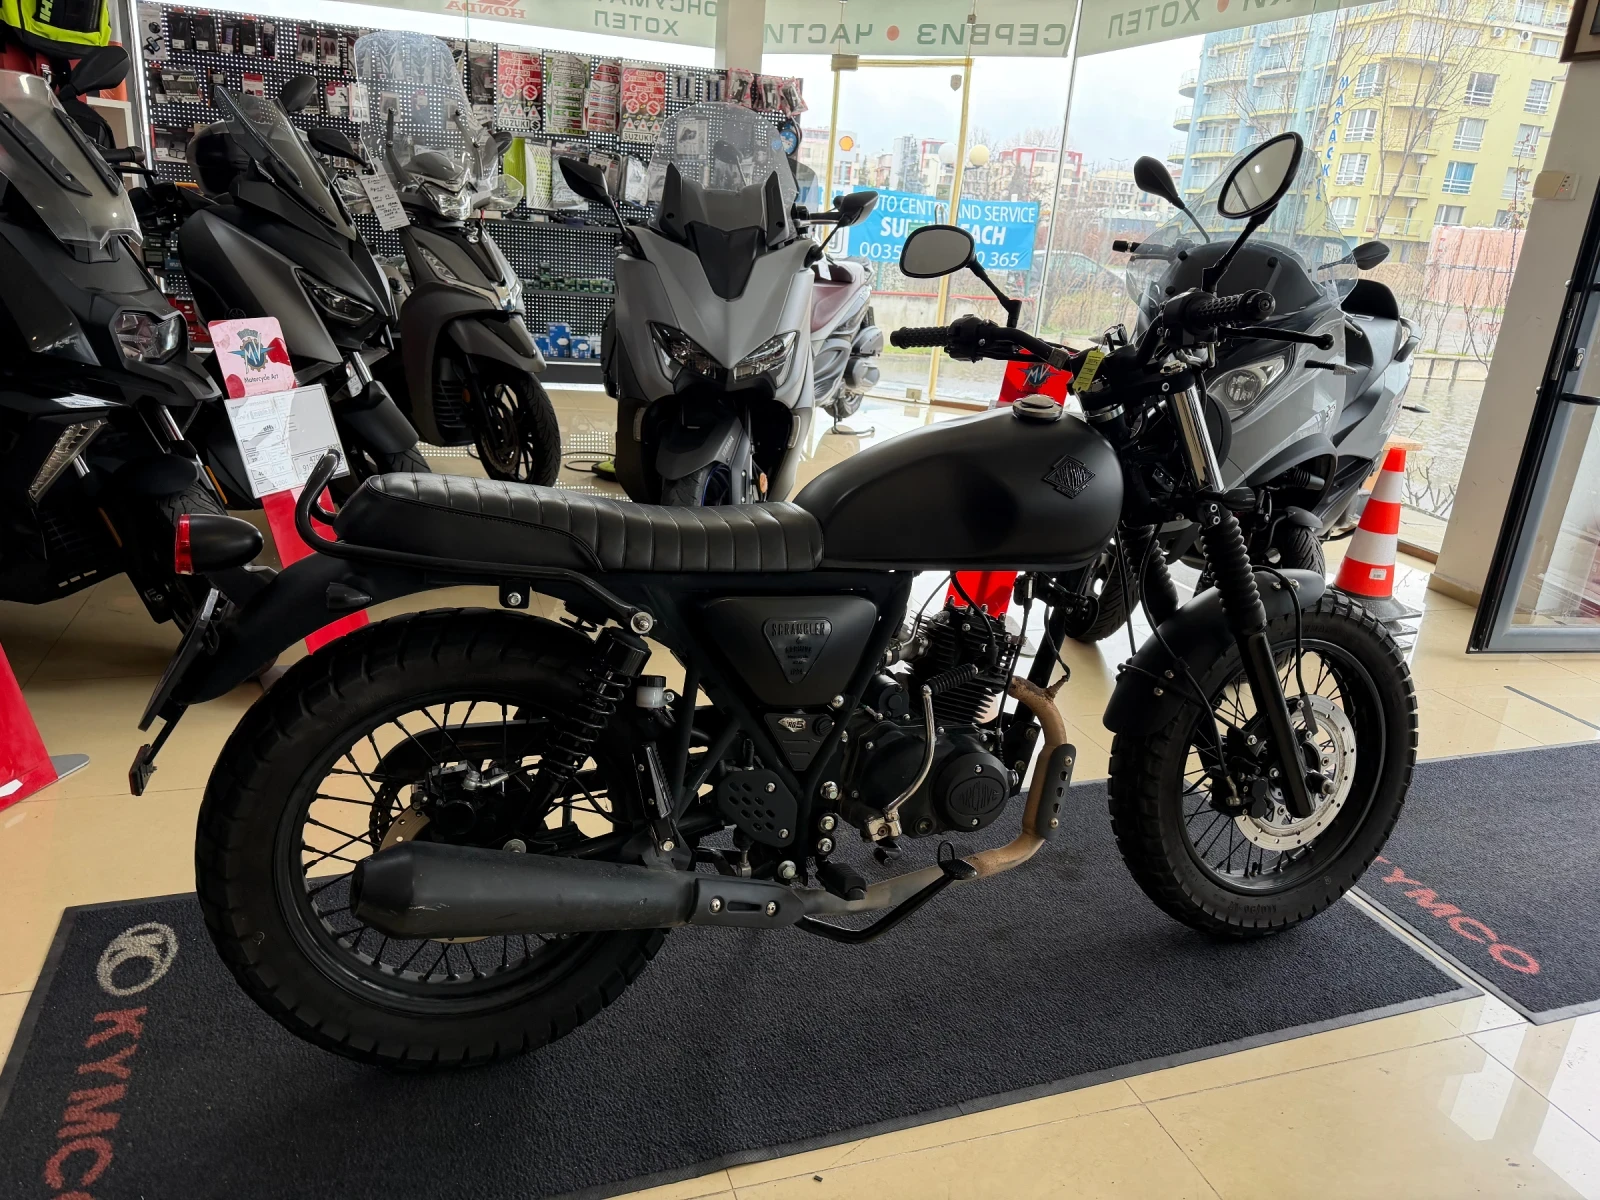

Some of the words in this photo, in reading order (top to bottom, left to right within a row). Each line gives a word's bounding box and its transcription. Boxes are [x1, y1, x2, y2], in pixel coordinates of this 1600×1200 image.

[500, 119, 529, 128] SUZUKI
[624, 132, 652, 141] SUZUKI
[984, 205, 1036, 224] SERVICE
[988, 252, 1020, 267] 365
[1022, 364, 1051, 387] MV
[1373, 855, 1541, 975] YMCO
[44, 1005, 149, 1200] KYMC
